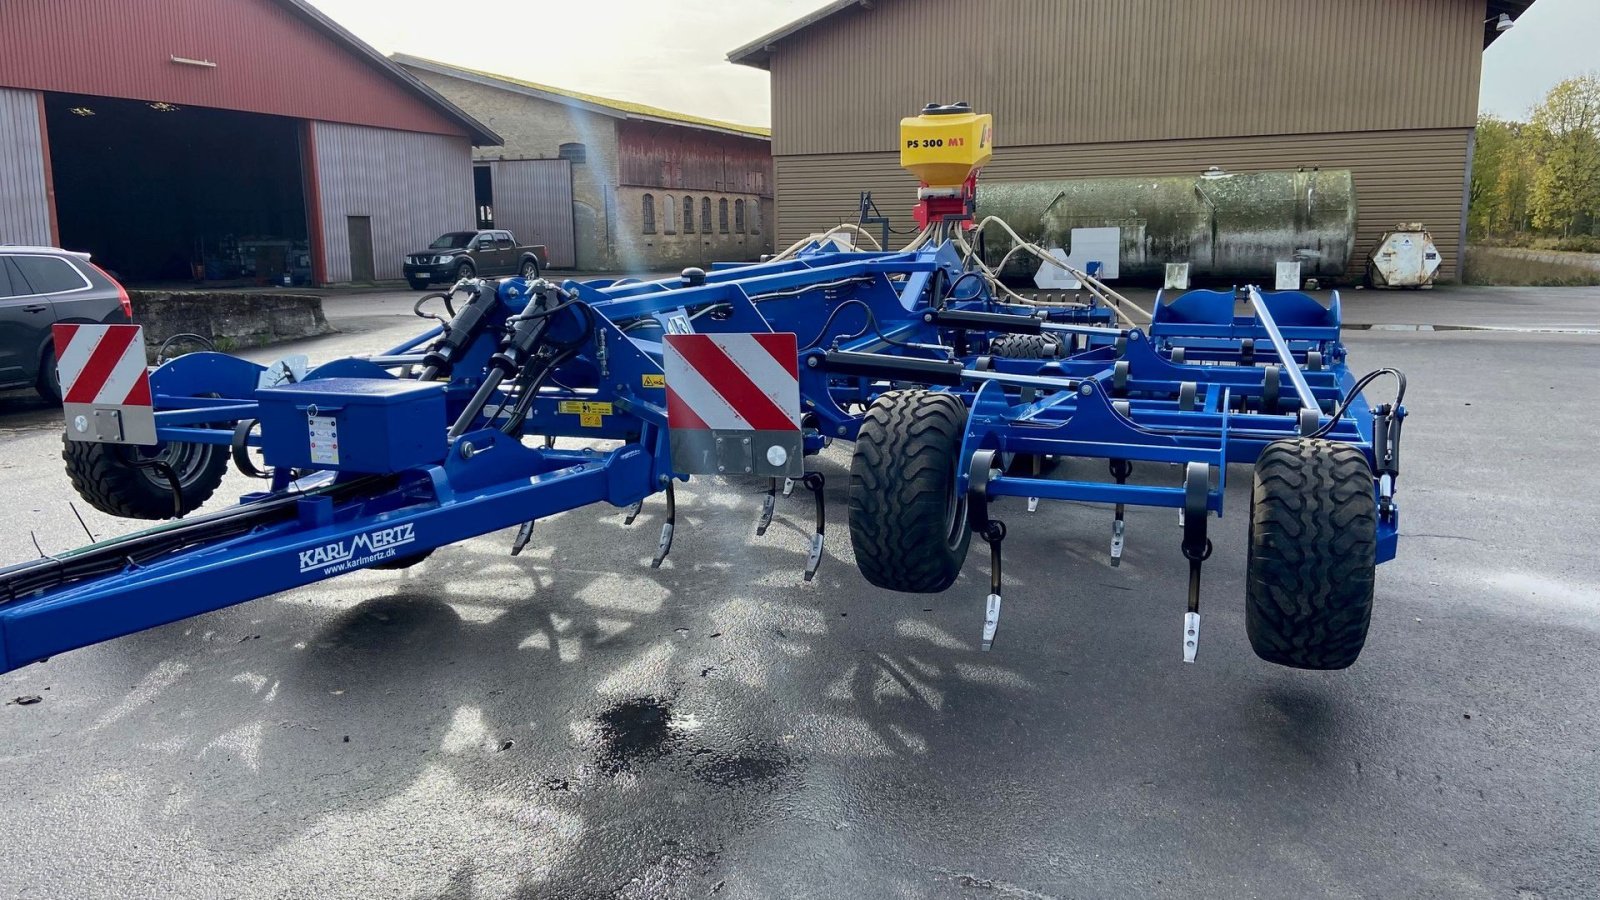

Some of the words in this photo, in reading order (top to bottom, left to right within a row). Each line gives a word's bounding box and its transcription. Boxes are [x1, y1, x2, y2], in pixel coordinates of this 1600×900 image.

[907, 140, 919, 148] PS
[922, 139, 943, 147] 300
[947, 138, 964, 146] M1
[323, 547, 396, 575] www.karlmertz.dk
